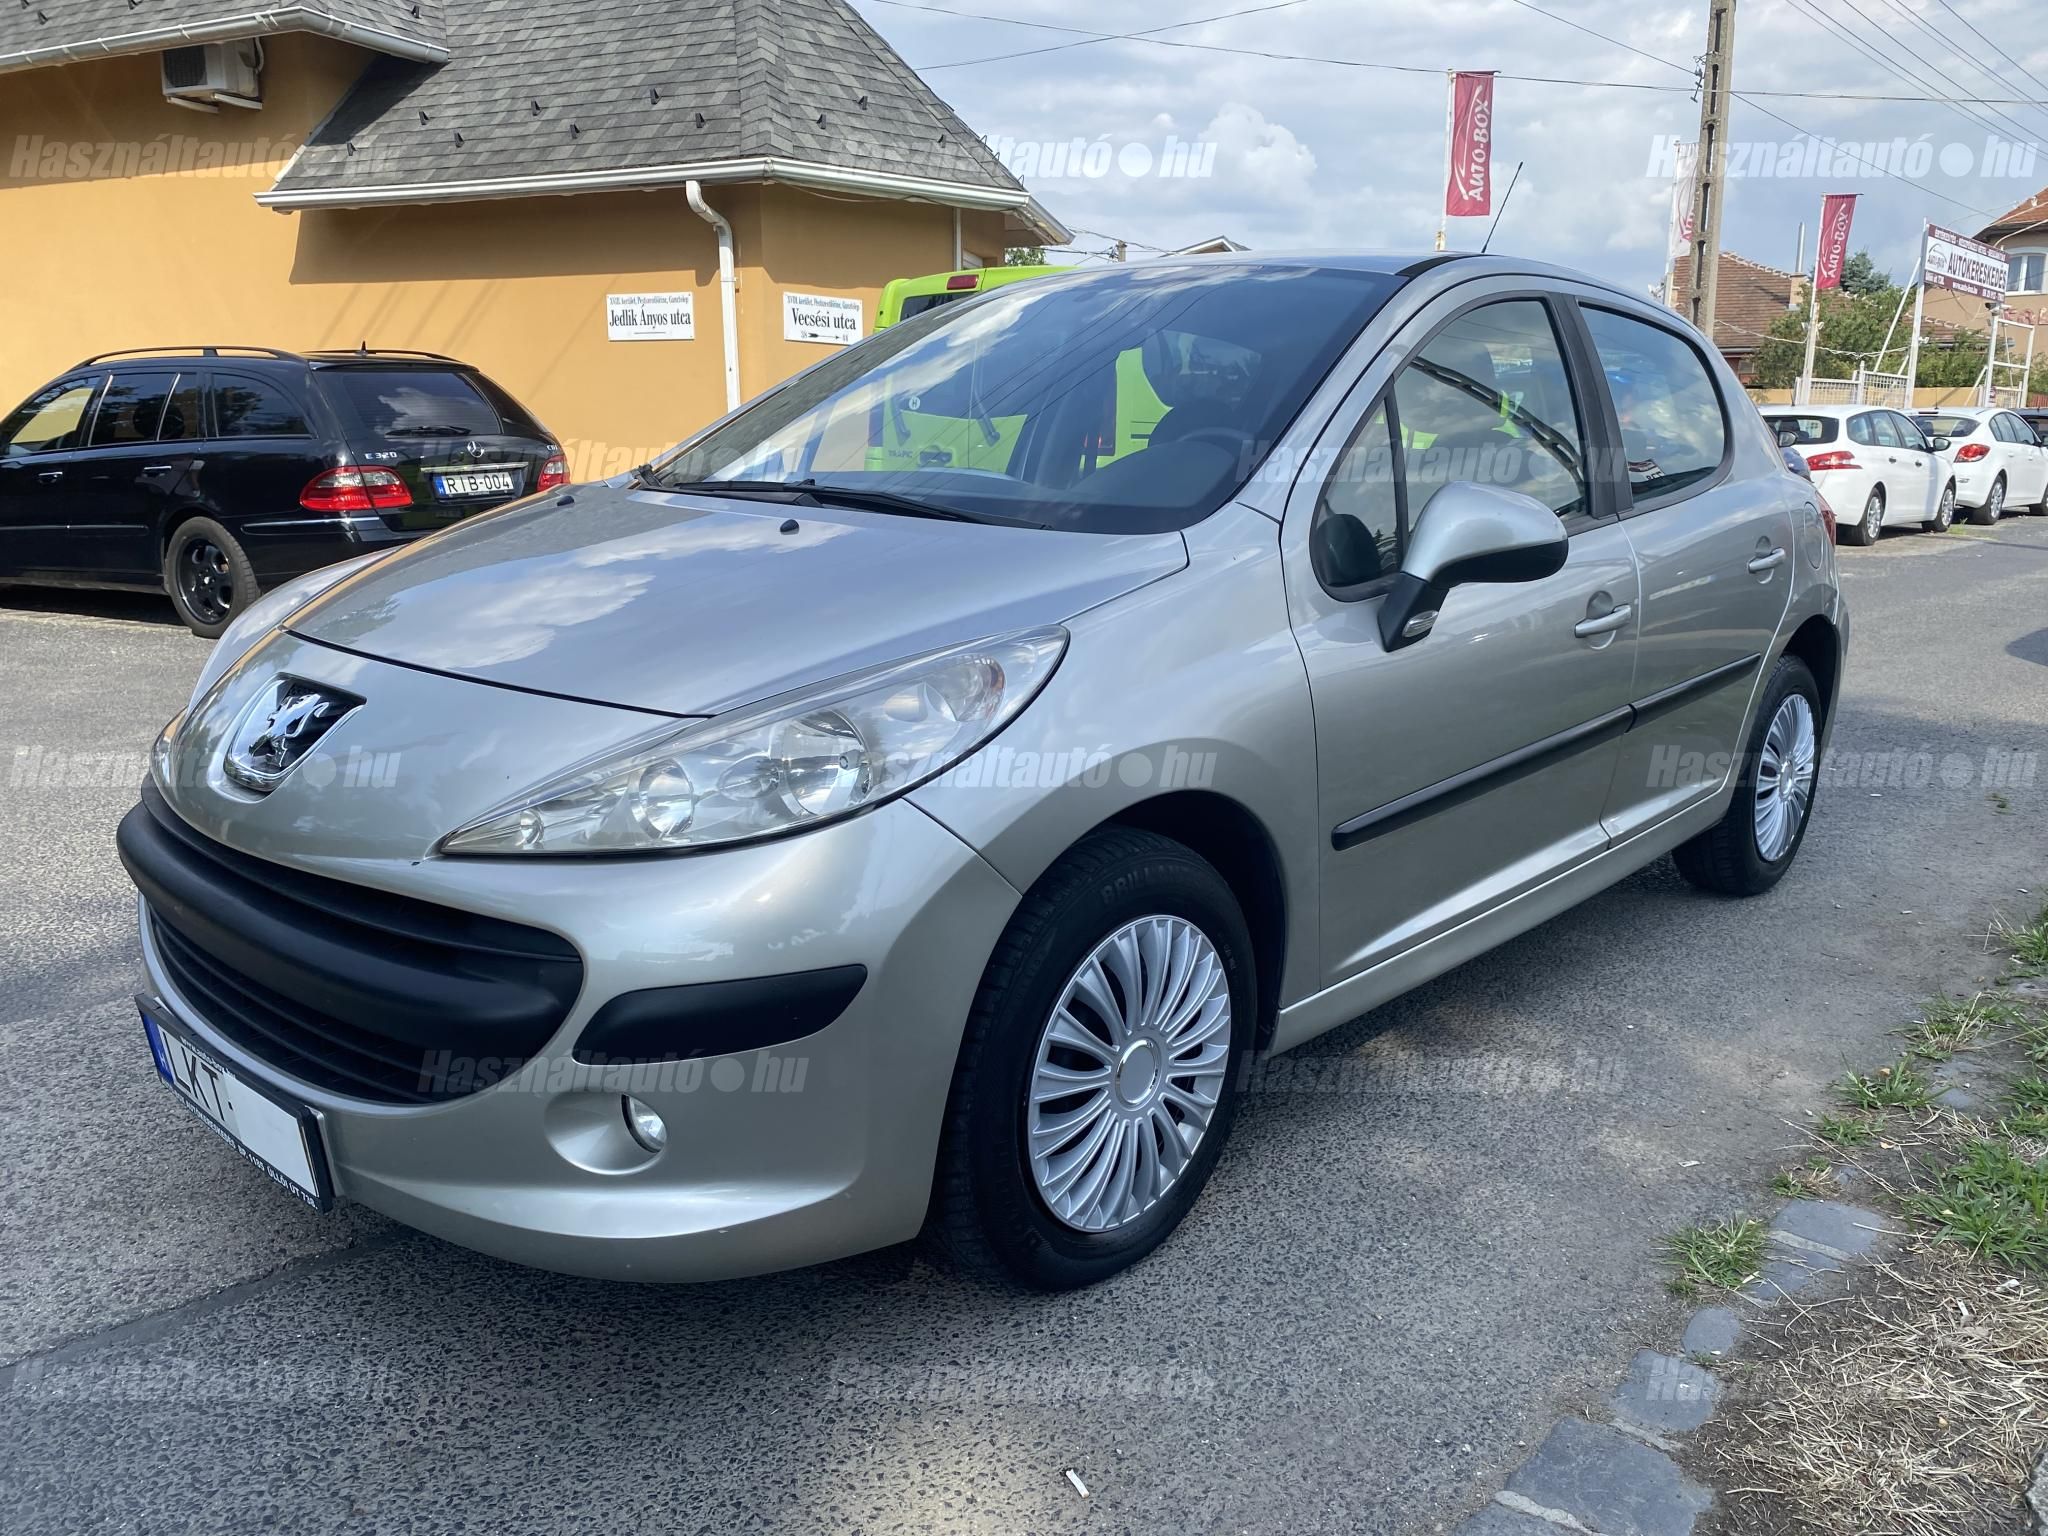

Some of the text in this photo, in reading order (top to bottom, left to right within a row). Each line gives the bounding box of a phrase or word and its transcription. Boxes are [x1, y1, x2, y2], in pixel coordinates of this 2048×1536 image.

[609, 304, 692, 329] Jedlik Ányos utca
[792, 307, 857, 330] Vecsési utca
[375, 451, 398, 459] 320
[446, 473, 510, 493] RIB-004
